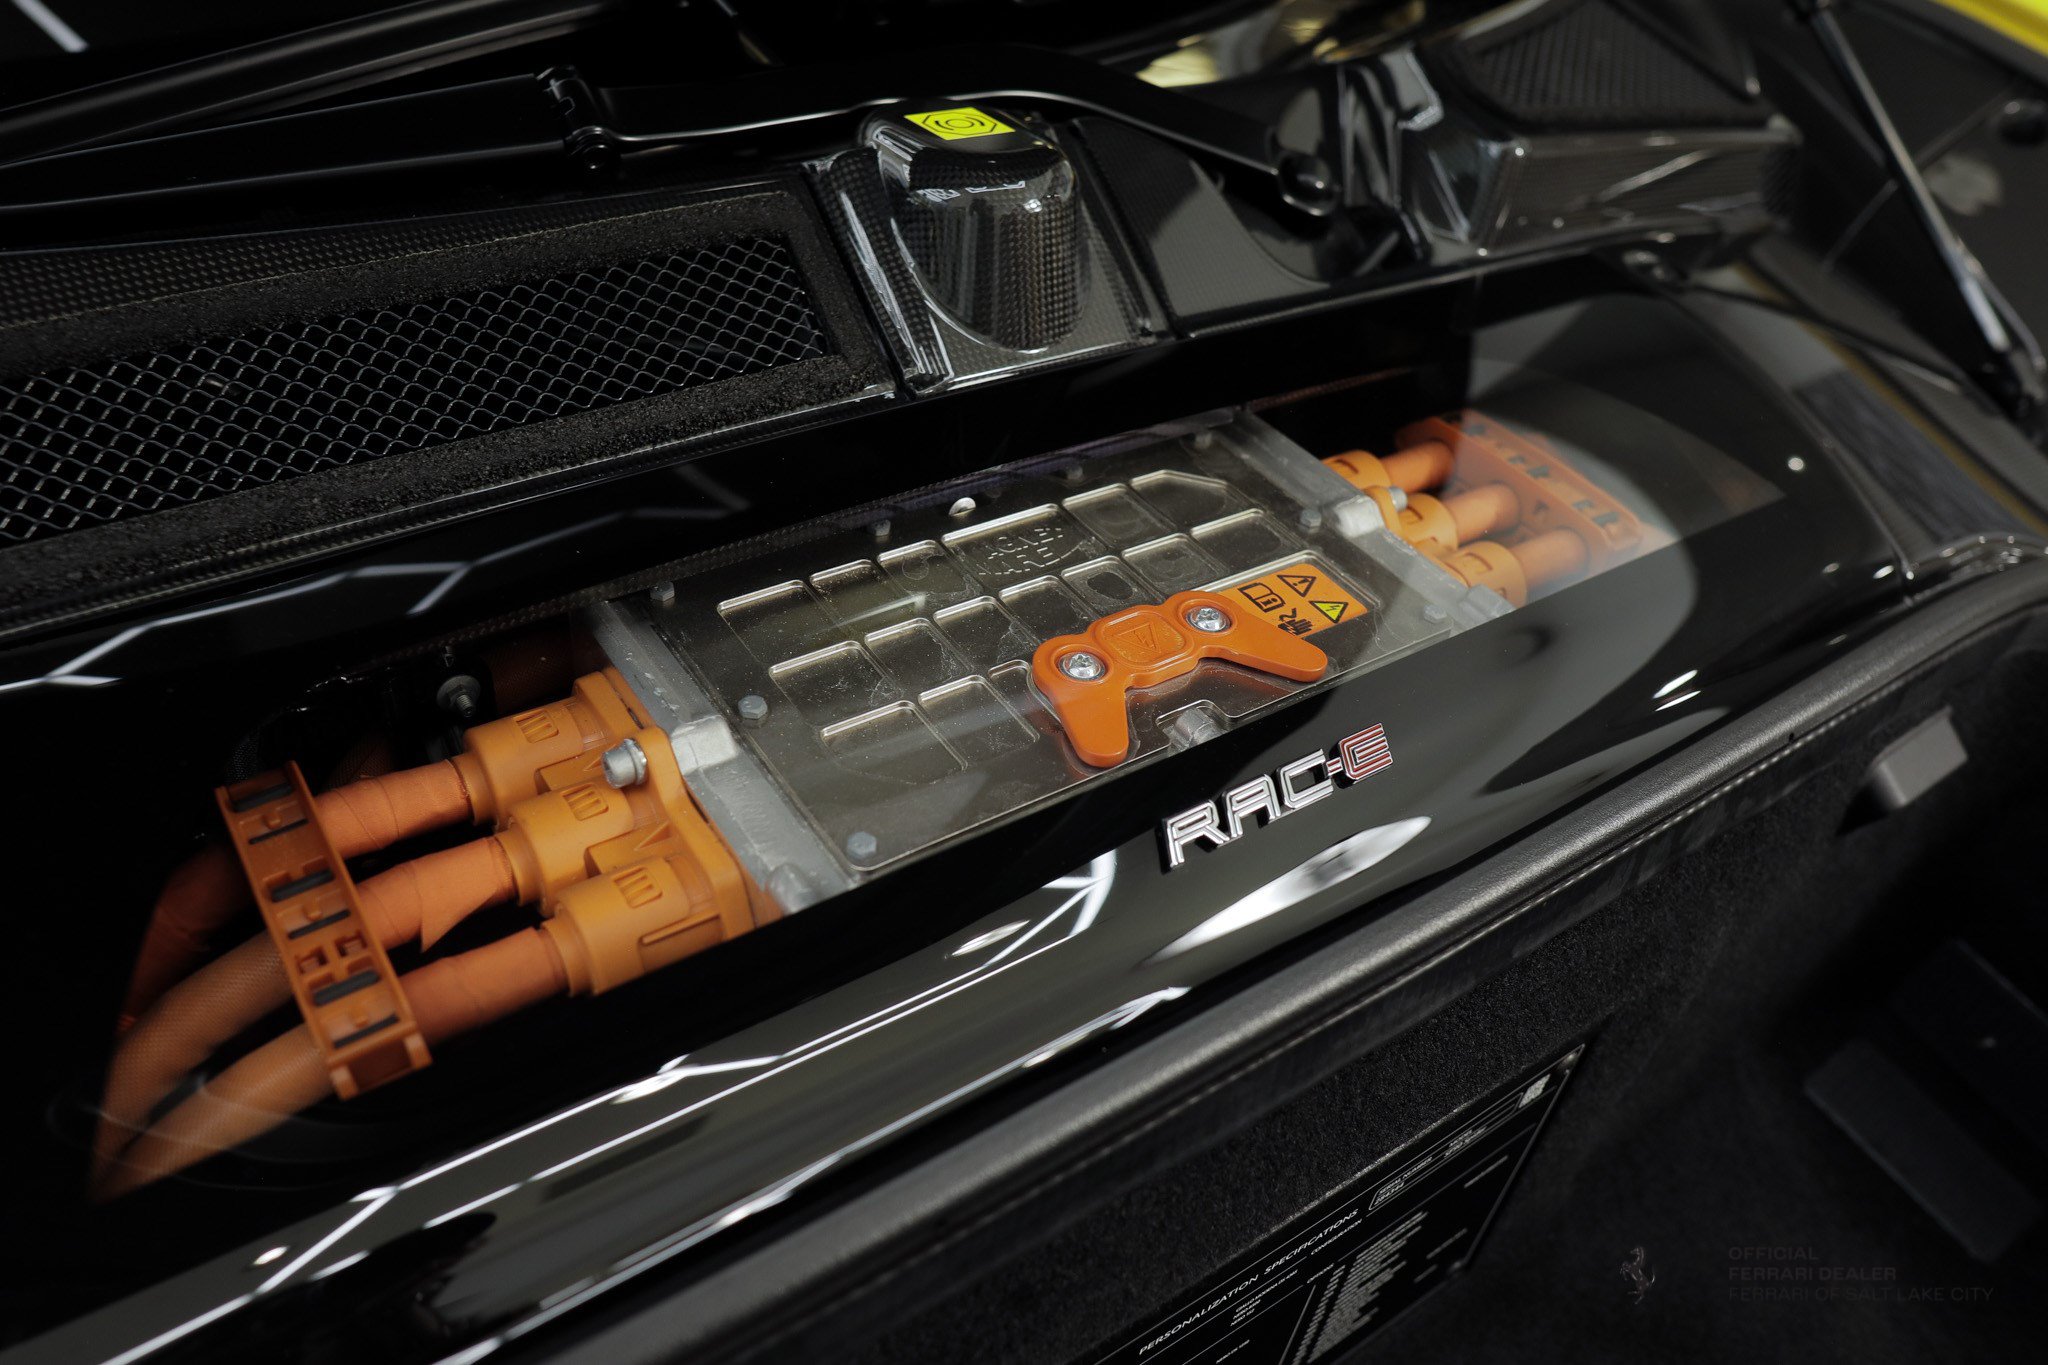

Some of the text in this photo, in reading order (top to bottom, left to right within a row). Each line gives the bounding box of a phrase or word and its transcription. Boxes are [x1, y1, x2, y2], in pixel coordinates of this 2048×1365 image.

[1164, 722, 1393, 869] RAC-E
[1139, 1274, 1259, 1356] PERSONALIZATION
[1264, 1208, 1358, 1275] SPECIFICATIONS
